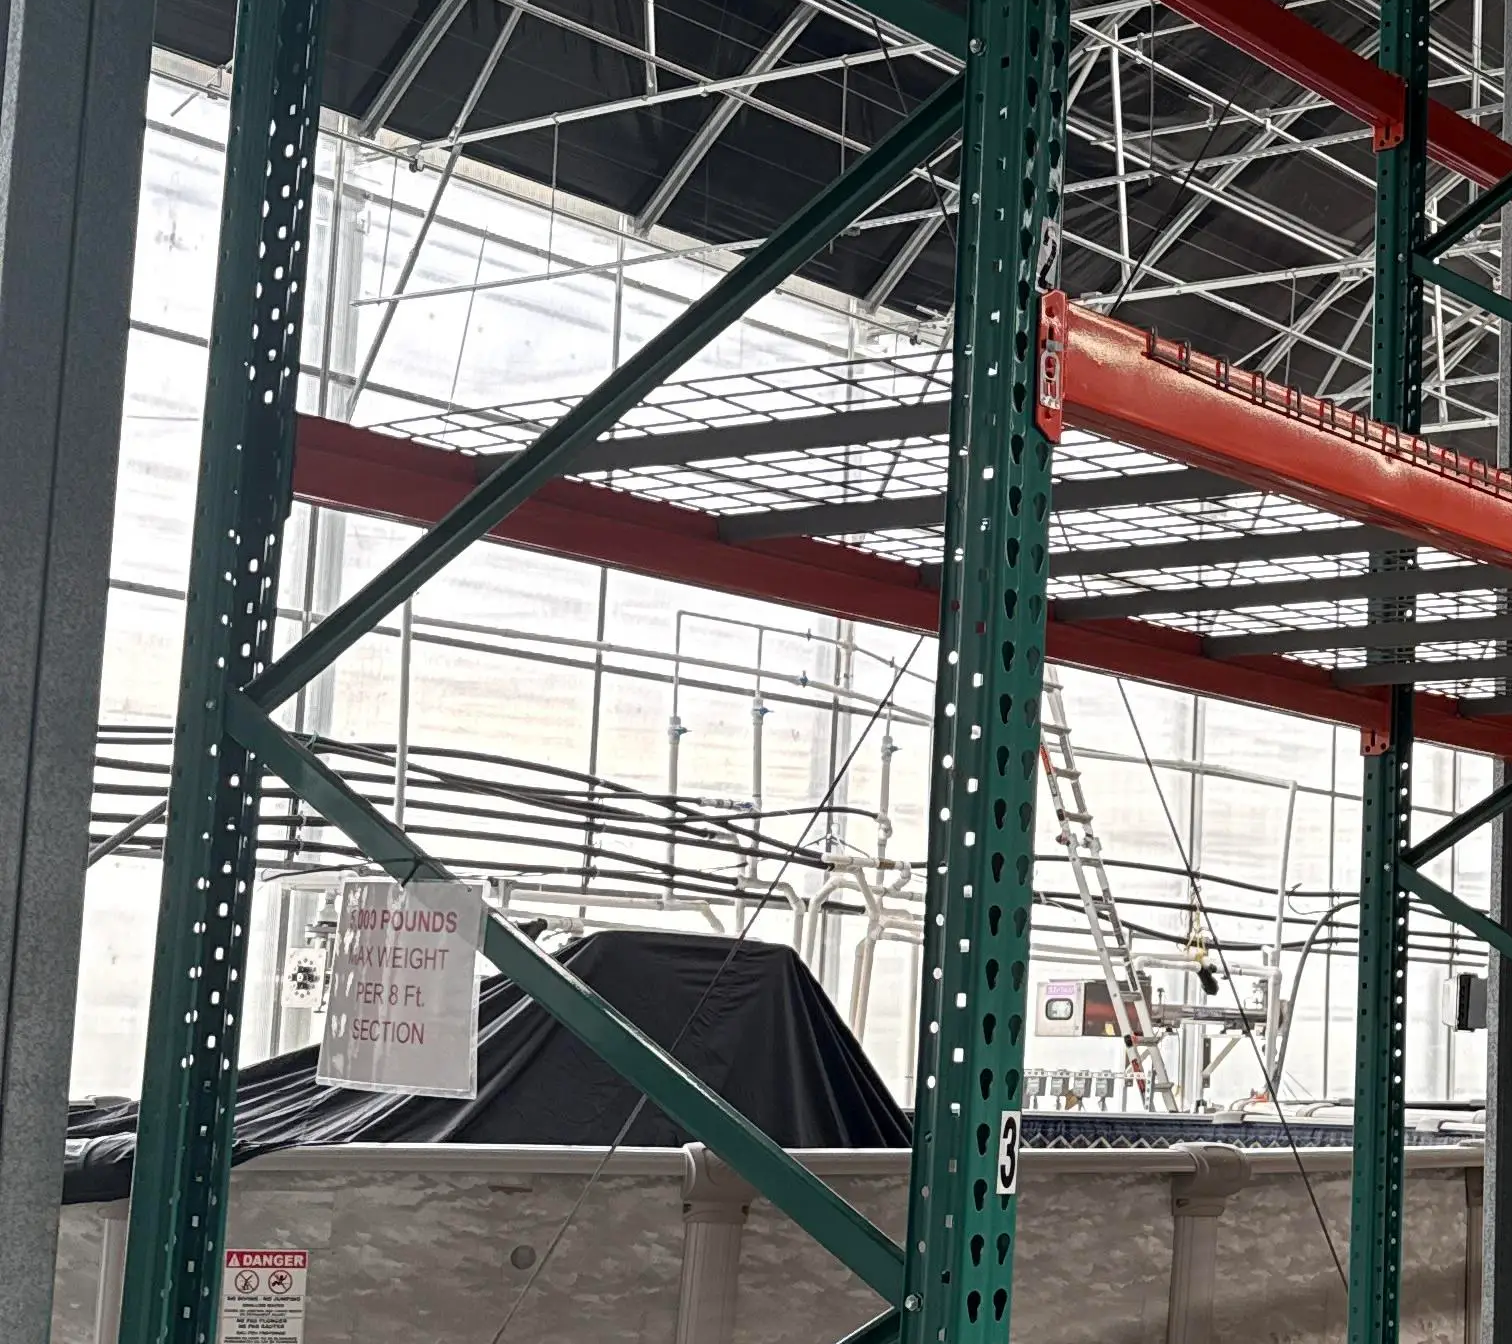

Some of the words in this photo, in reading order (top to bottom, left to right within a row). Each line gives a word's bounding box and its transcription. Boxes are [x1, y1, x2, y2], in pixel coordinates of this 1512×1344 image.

[1038, 226, 1057, 290] 2
[381, 909, 458, 933] POUNDS
[377, 945, 450, 971] WEIGHT
[356, 981, 384, 1005] PER
[388, 984, 399, 1006] 8
[404, 985, 425, 1008] Ft.
[352, 1017, 425, 1045] SECTION
[1000, 1116, 1017, 1189] 3
[242, 1254, 304, 1267] DANGER
